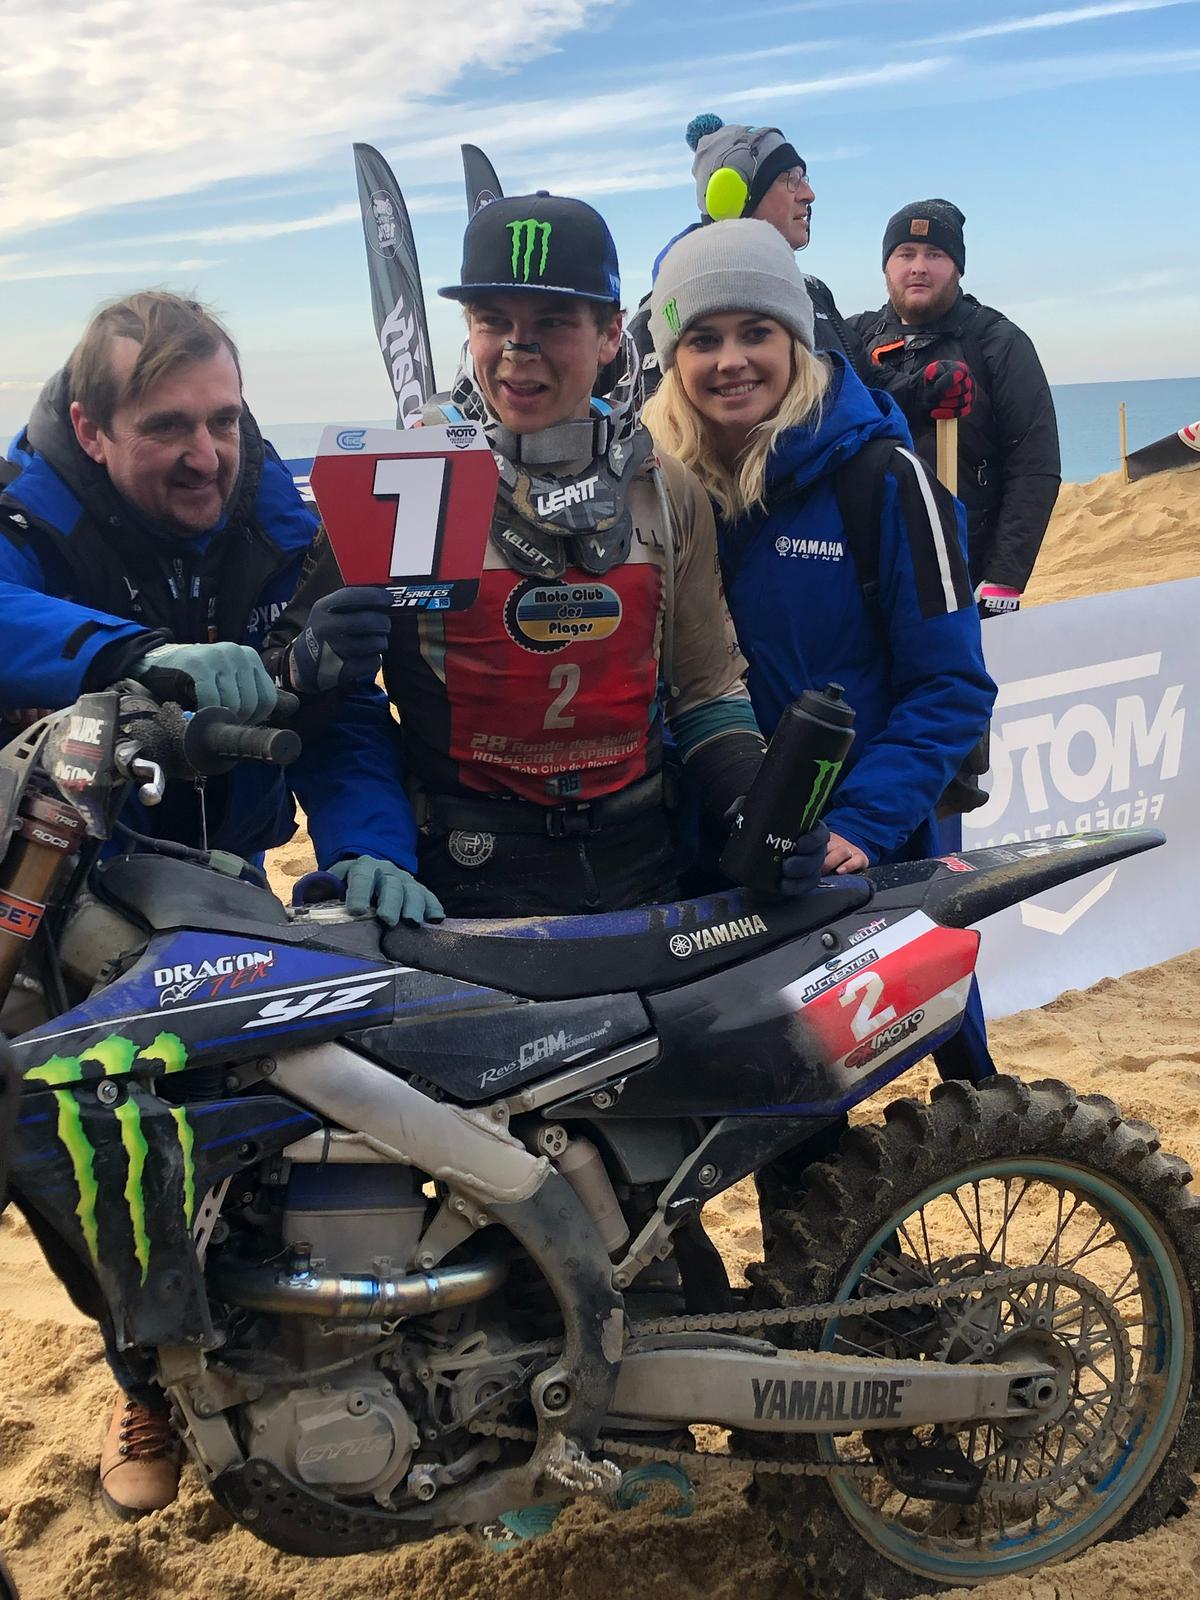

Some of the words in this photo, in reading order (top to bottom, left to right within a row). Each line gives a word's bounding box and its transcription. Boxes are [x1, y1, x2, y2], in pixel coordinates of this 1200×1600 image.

[446, 428, 477, 437] MOTO
[612, 444, 624, 459] 2
[538, 476, 599, 516] LEATT
[373, 457, 446, 577] 1
[502, 529, 553, 567] KELLETT
[779, 552, 840, 562] RACING
[792, 538, 844, 557] YAMAHA
[534, 590, 569, 603] Moto
[572, 588, 604, 602] Club
[558, 606, 582, 618] des
[549, 622, 593, 636] Plages
[543, 663, 581, 730] 2
[470, 733, 508, 751] 28
[569, 738, 597, 749] des
[472, 751, 555, 765] HOSSEGOR
[541, 763, 566, 774] Club
[692, 913, 768, 950] YAMAHA
[848, 918, 889, 946] KELLETT
[210, 958, 277, 997] TEX
[241, 981, 393, 1030] YZ
[838, 971, 897, 1043] 2
[477, 1060, 517, 1089] Revs
[751, 1378, 905, 1421] YAMALUBE
